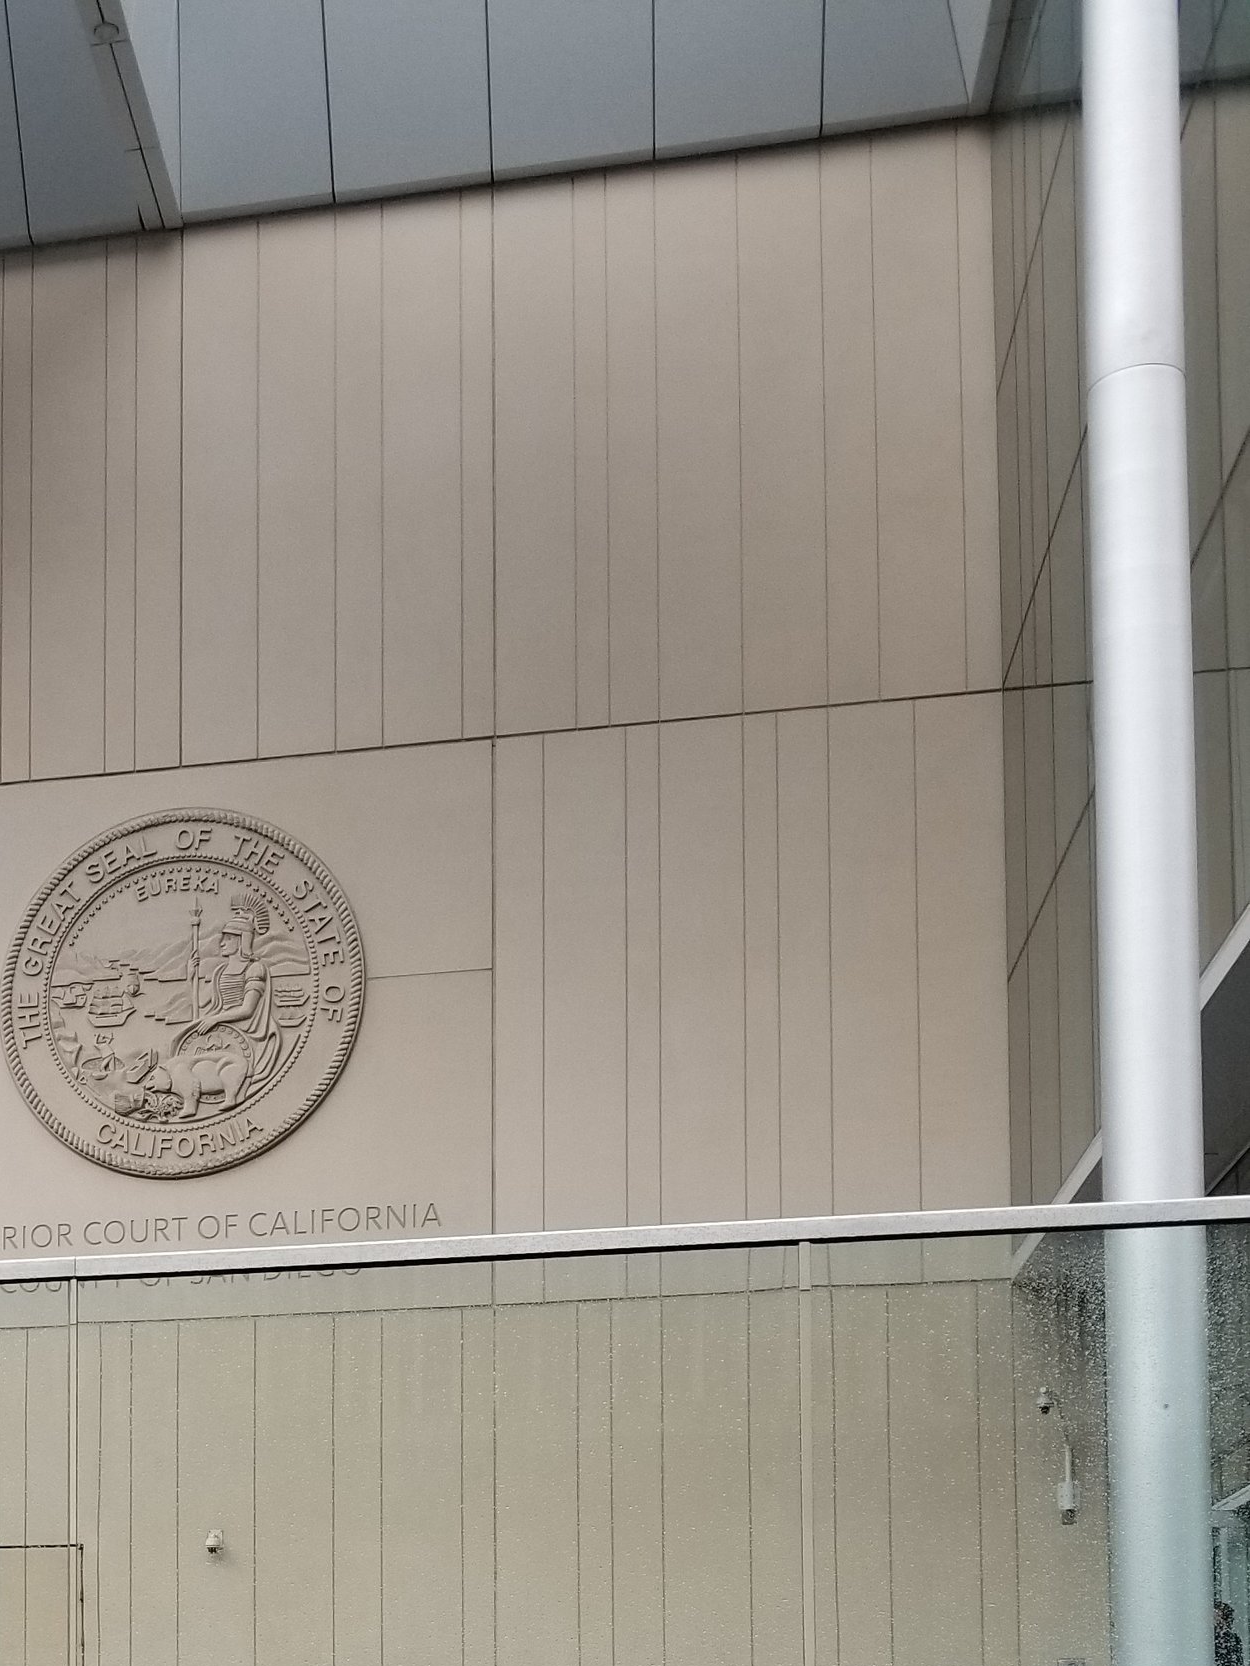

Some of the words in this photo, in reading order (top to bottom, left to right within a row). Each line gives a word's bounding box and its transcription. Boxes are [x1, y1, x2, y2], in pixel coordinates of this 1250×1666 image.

[174, 828, 213, 852] OF
[233, 835, 285, 875] THE
[85, 840, 158, 885] SEAL
[136, 876, 221, 902] EUREKA
[21, 880, 83, 977] GREAT
[291, 878, 346, 967] STATE
[17, 990, 43, 1050] THE
[319, 984, 346, 1024] OF
[96, 1117, 265, 1159] CALIFORNIA
[83, 1216, 189, 1247] COURT
[197, 1213, 240, 1240] OF
[248, 1202, 443, 1238] CALIFORNIA
